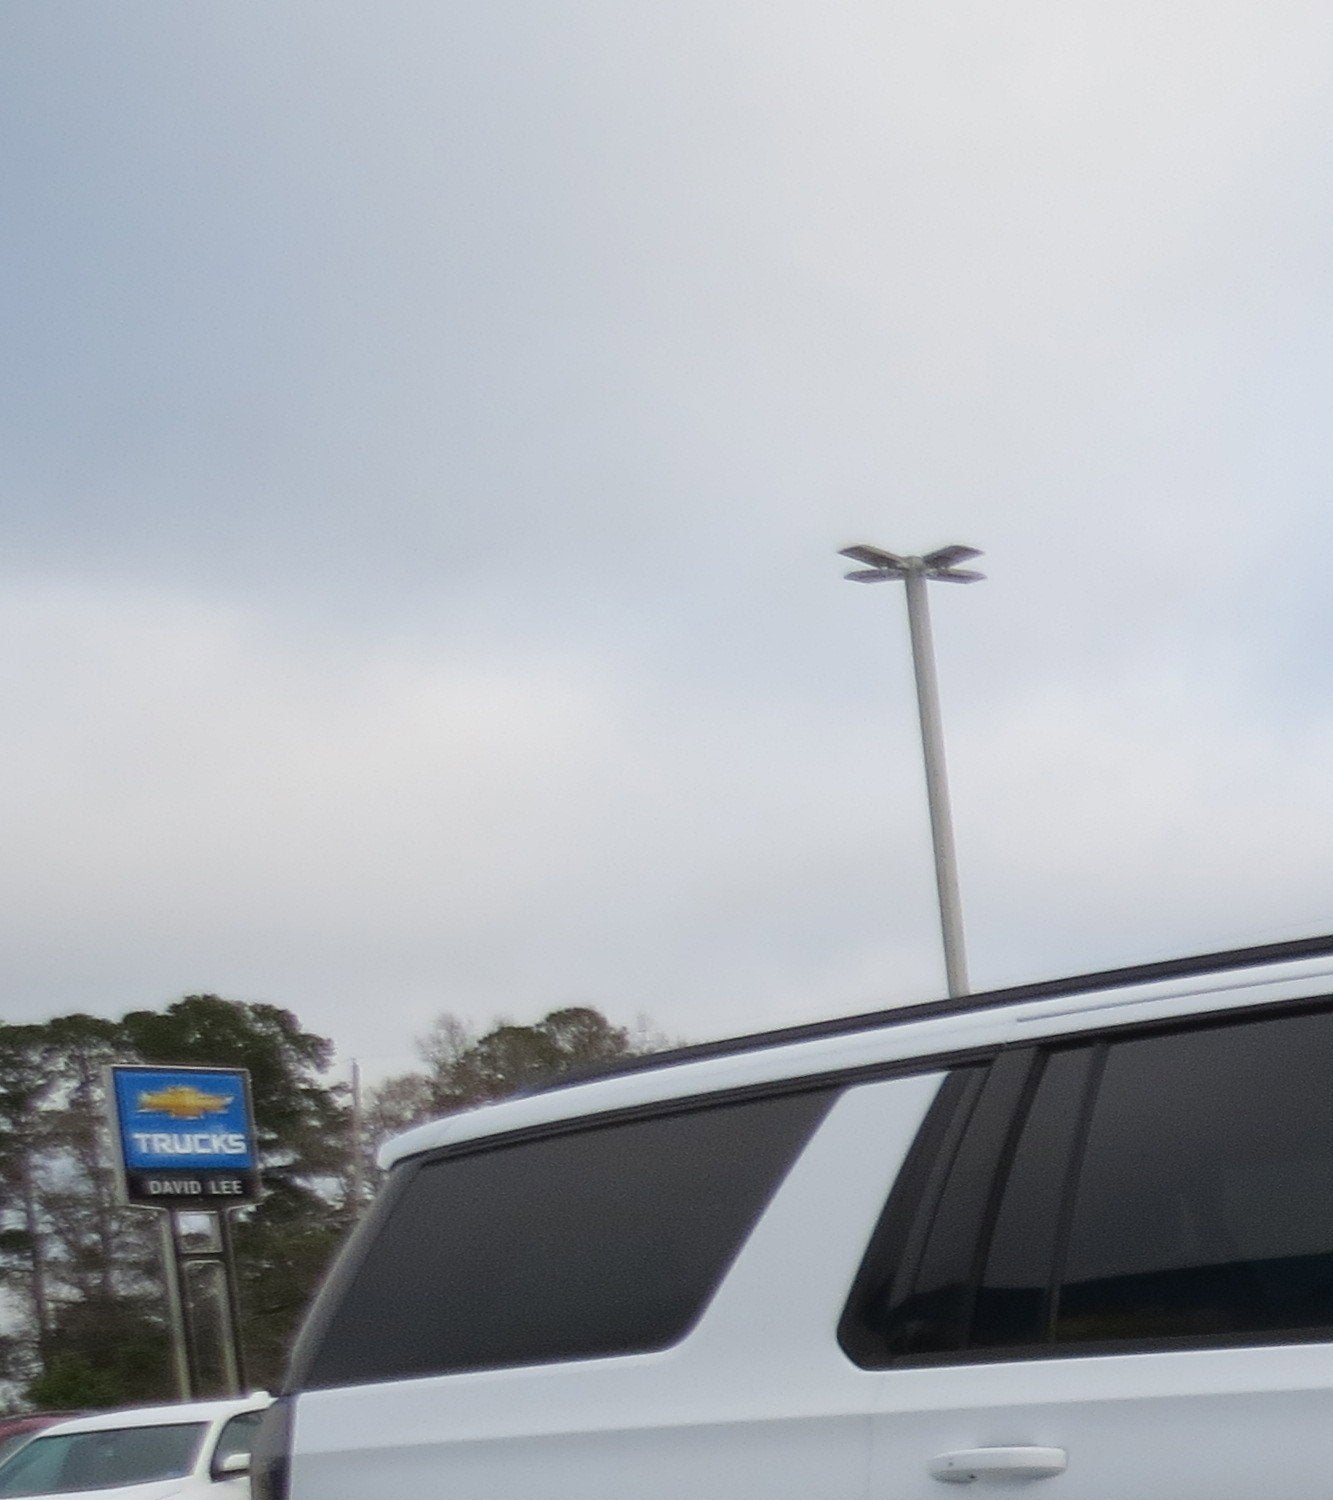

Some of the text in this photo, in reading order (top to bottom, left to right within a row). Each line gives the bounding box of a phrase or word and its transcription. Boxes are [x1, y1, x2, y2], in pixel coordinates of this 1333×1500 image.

[132, 1133, 248, 1154] TRUCKS
[150, 1180, 244, 1195] DAVID LEE
